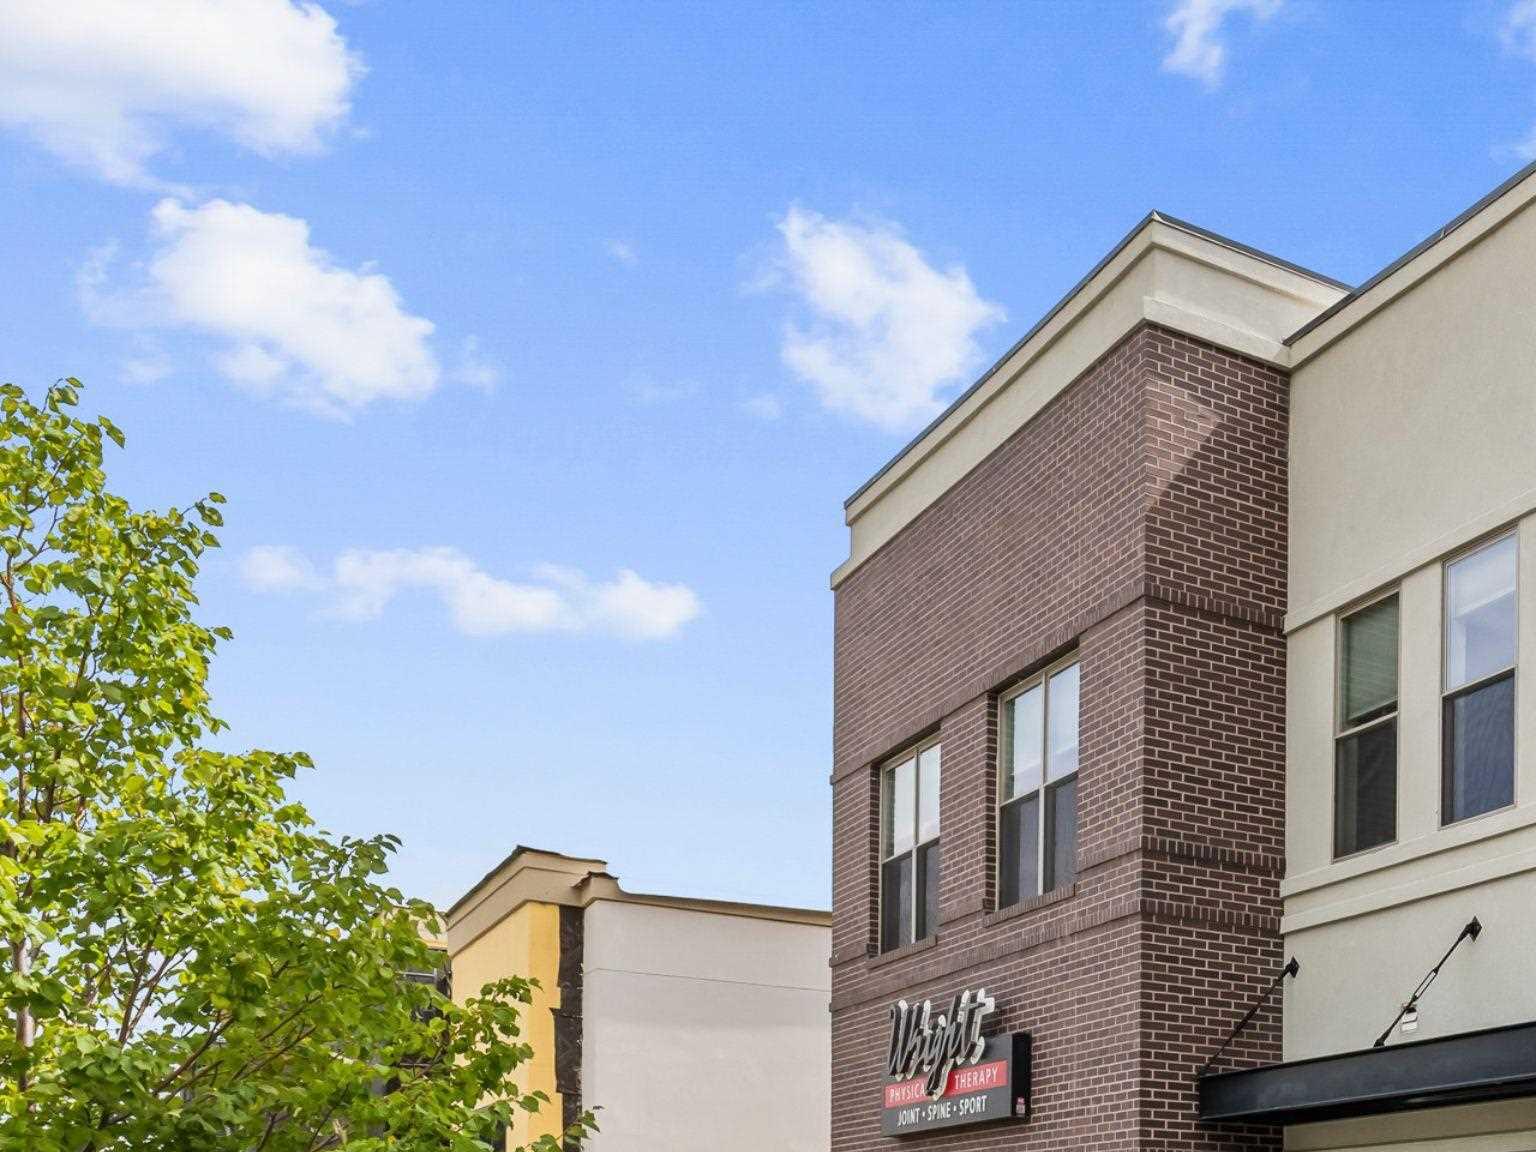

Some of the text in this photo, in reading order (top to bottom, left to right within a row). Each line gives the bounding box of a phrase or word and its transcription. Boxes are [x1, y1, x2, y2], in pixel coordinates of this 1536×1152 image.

[889, 1066, 999, 1103] PHYSICA THERAPY
[897, 1095, 988, 1127] JOINT SPINE SPORT
